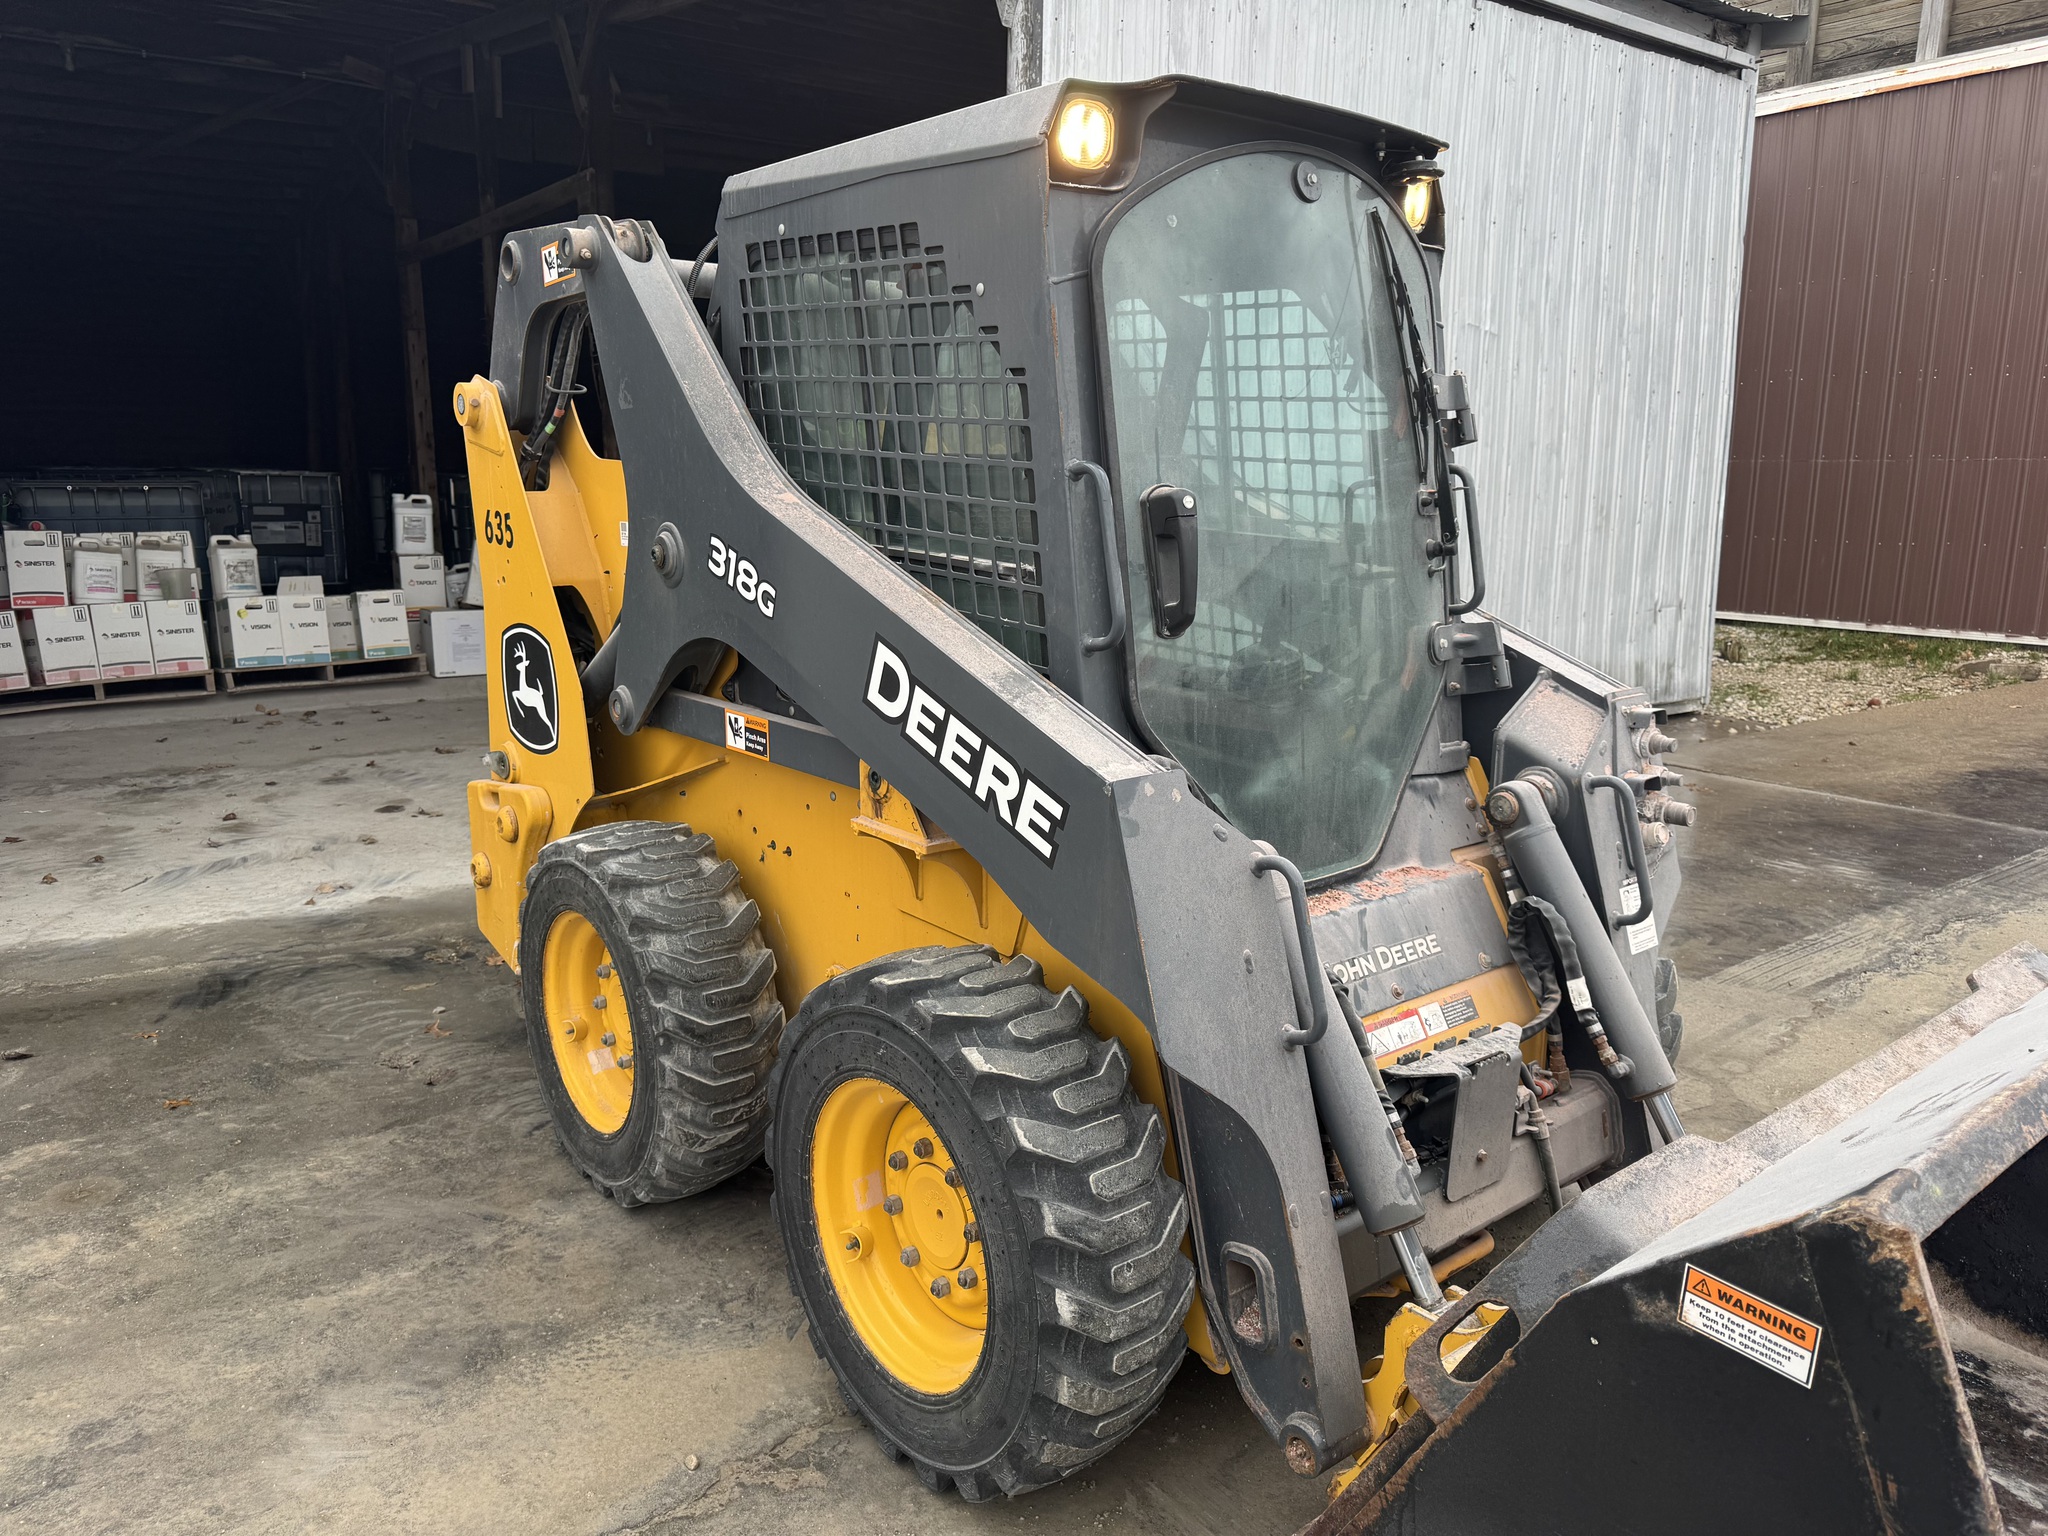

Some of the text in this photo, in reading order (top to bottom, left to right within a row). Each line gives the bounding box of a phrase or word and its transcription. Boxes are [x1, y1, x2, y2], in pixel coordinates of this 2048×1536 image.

[485, 509, 514, 549] 635
[708, 535, 776, 618] 318G
[54, 635, 85, 643] SINISTER
[110, 631, 141, 639] SINISTER
[165, 628, 195, 636] SINISTER
[866, 640, 1064, 860] DEERE
[1324, 933, 1442, 985] OHN DEERE
[1689, 1298, 1805, 1360] Keep 10 feet of clearance
[1699, 1311, 1792, 1362] from the attachment
[1717, 1288, 1808, 1342] WARNING
[1702, 1322, 1785, 1368] when in operation.
